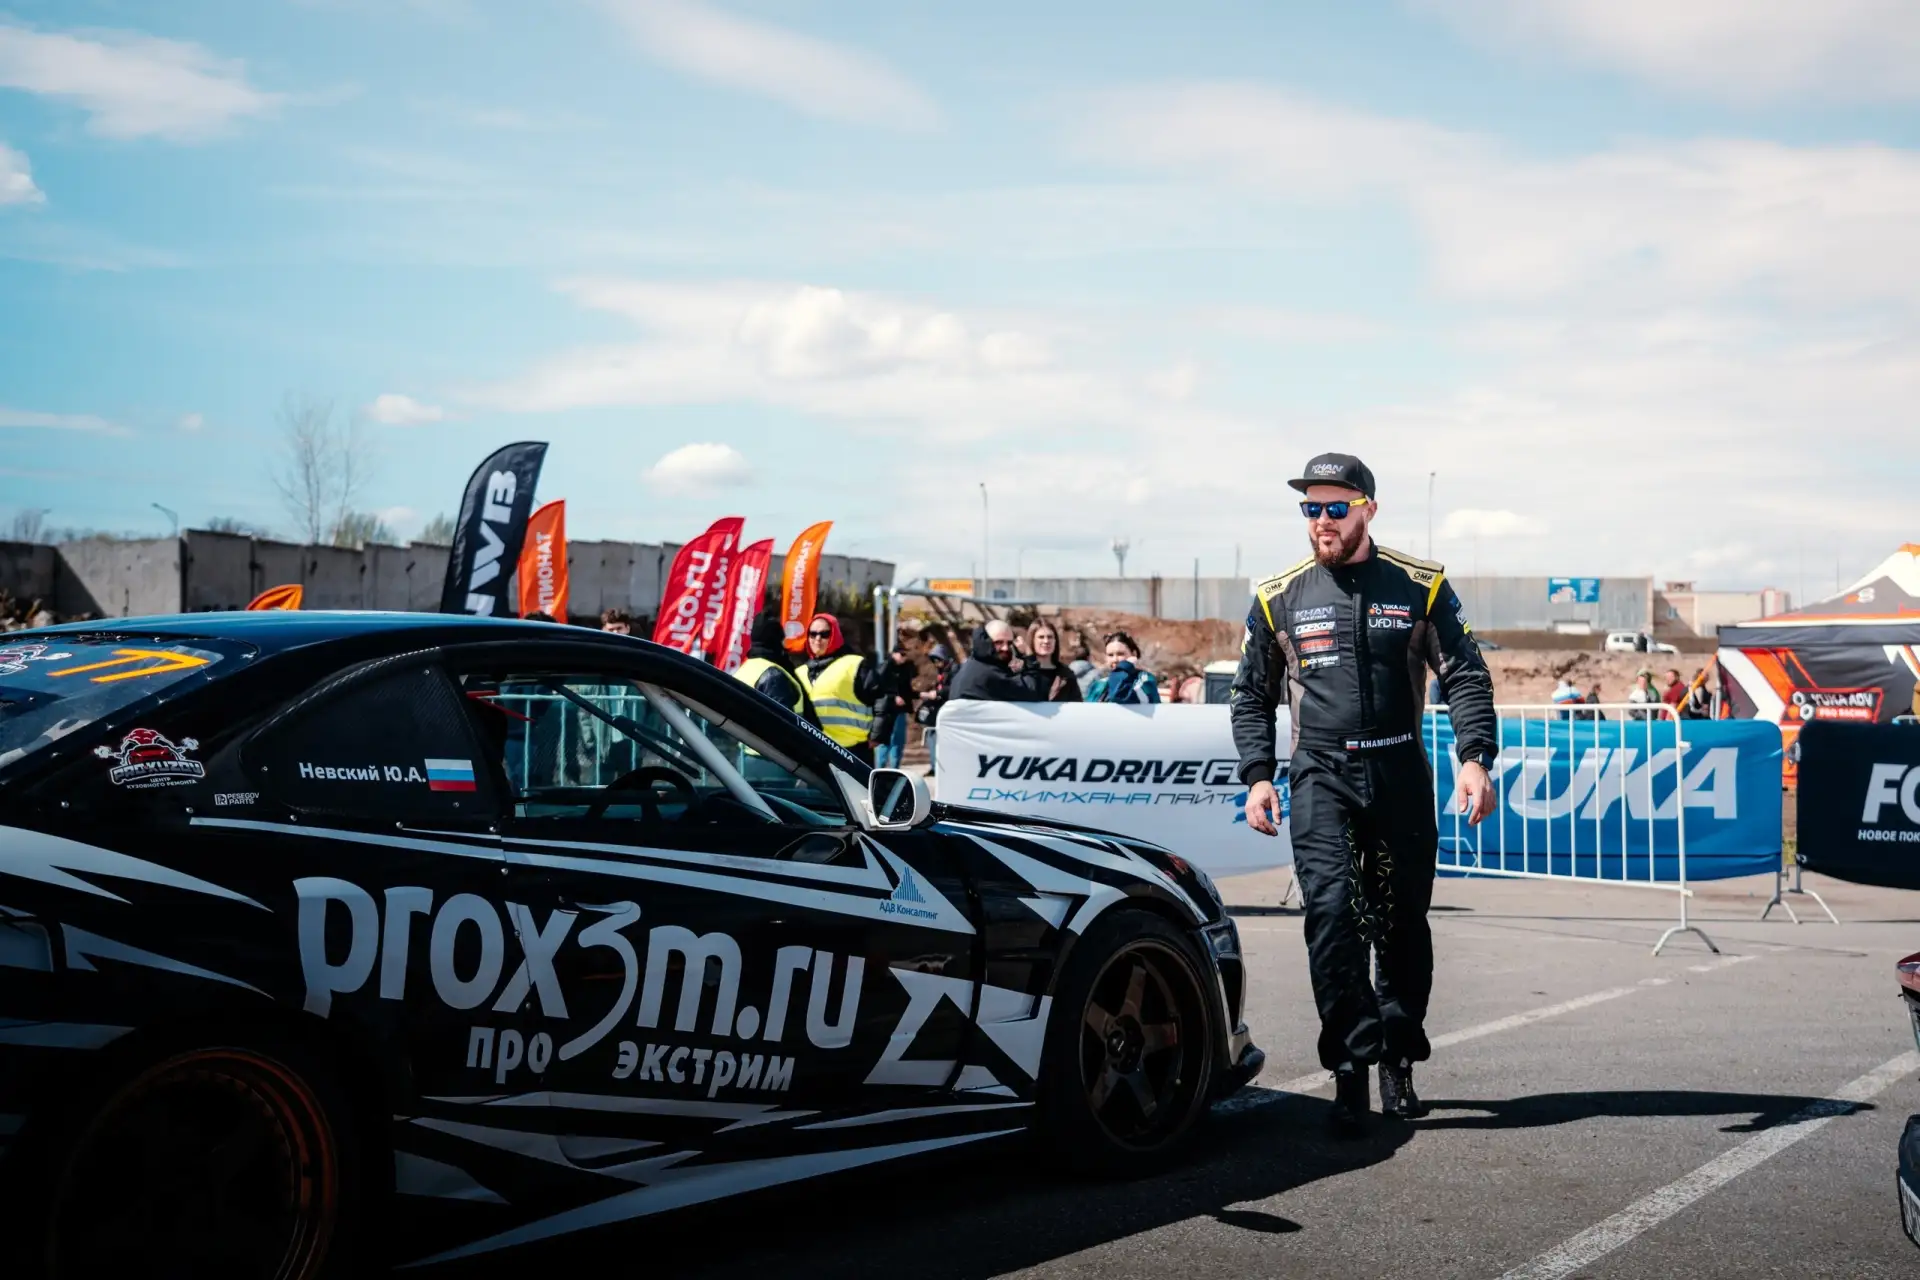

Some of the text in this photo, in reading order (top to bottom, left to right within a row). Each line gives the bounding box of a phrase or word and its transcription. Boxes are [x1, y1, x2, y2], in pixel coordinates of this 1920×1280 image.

[1413, 571, 1433, 581] OMP
[1265, 582, 1283, 593] OMP
[1296, 606, 1334, 618] KHAN
[800, 721, 854, 764] GYMKHANA
[299, 762, 427, 782] Невский Ю.А.
[966, 787, 1153, 805] ДЖИМХАНА
[1857, 829, 1897, 842] НОВОЕ
[896, 904, 939, 920] Консалтинг
